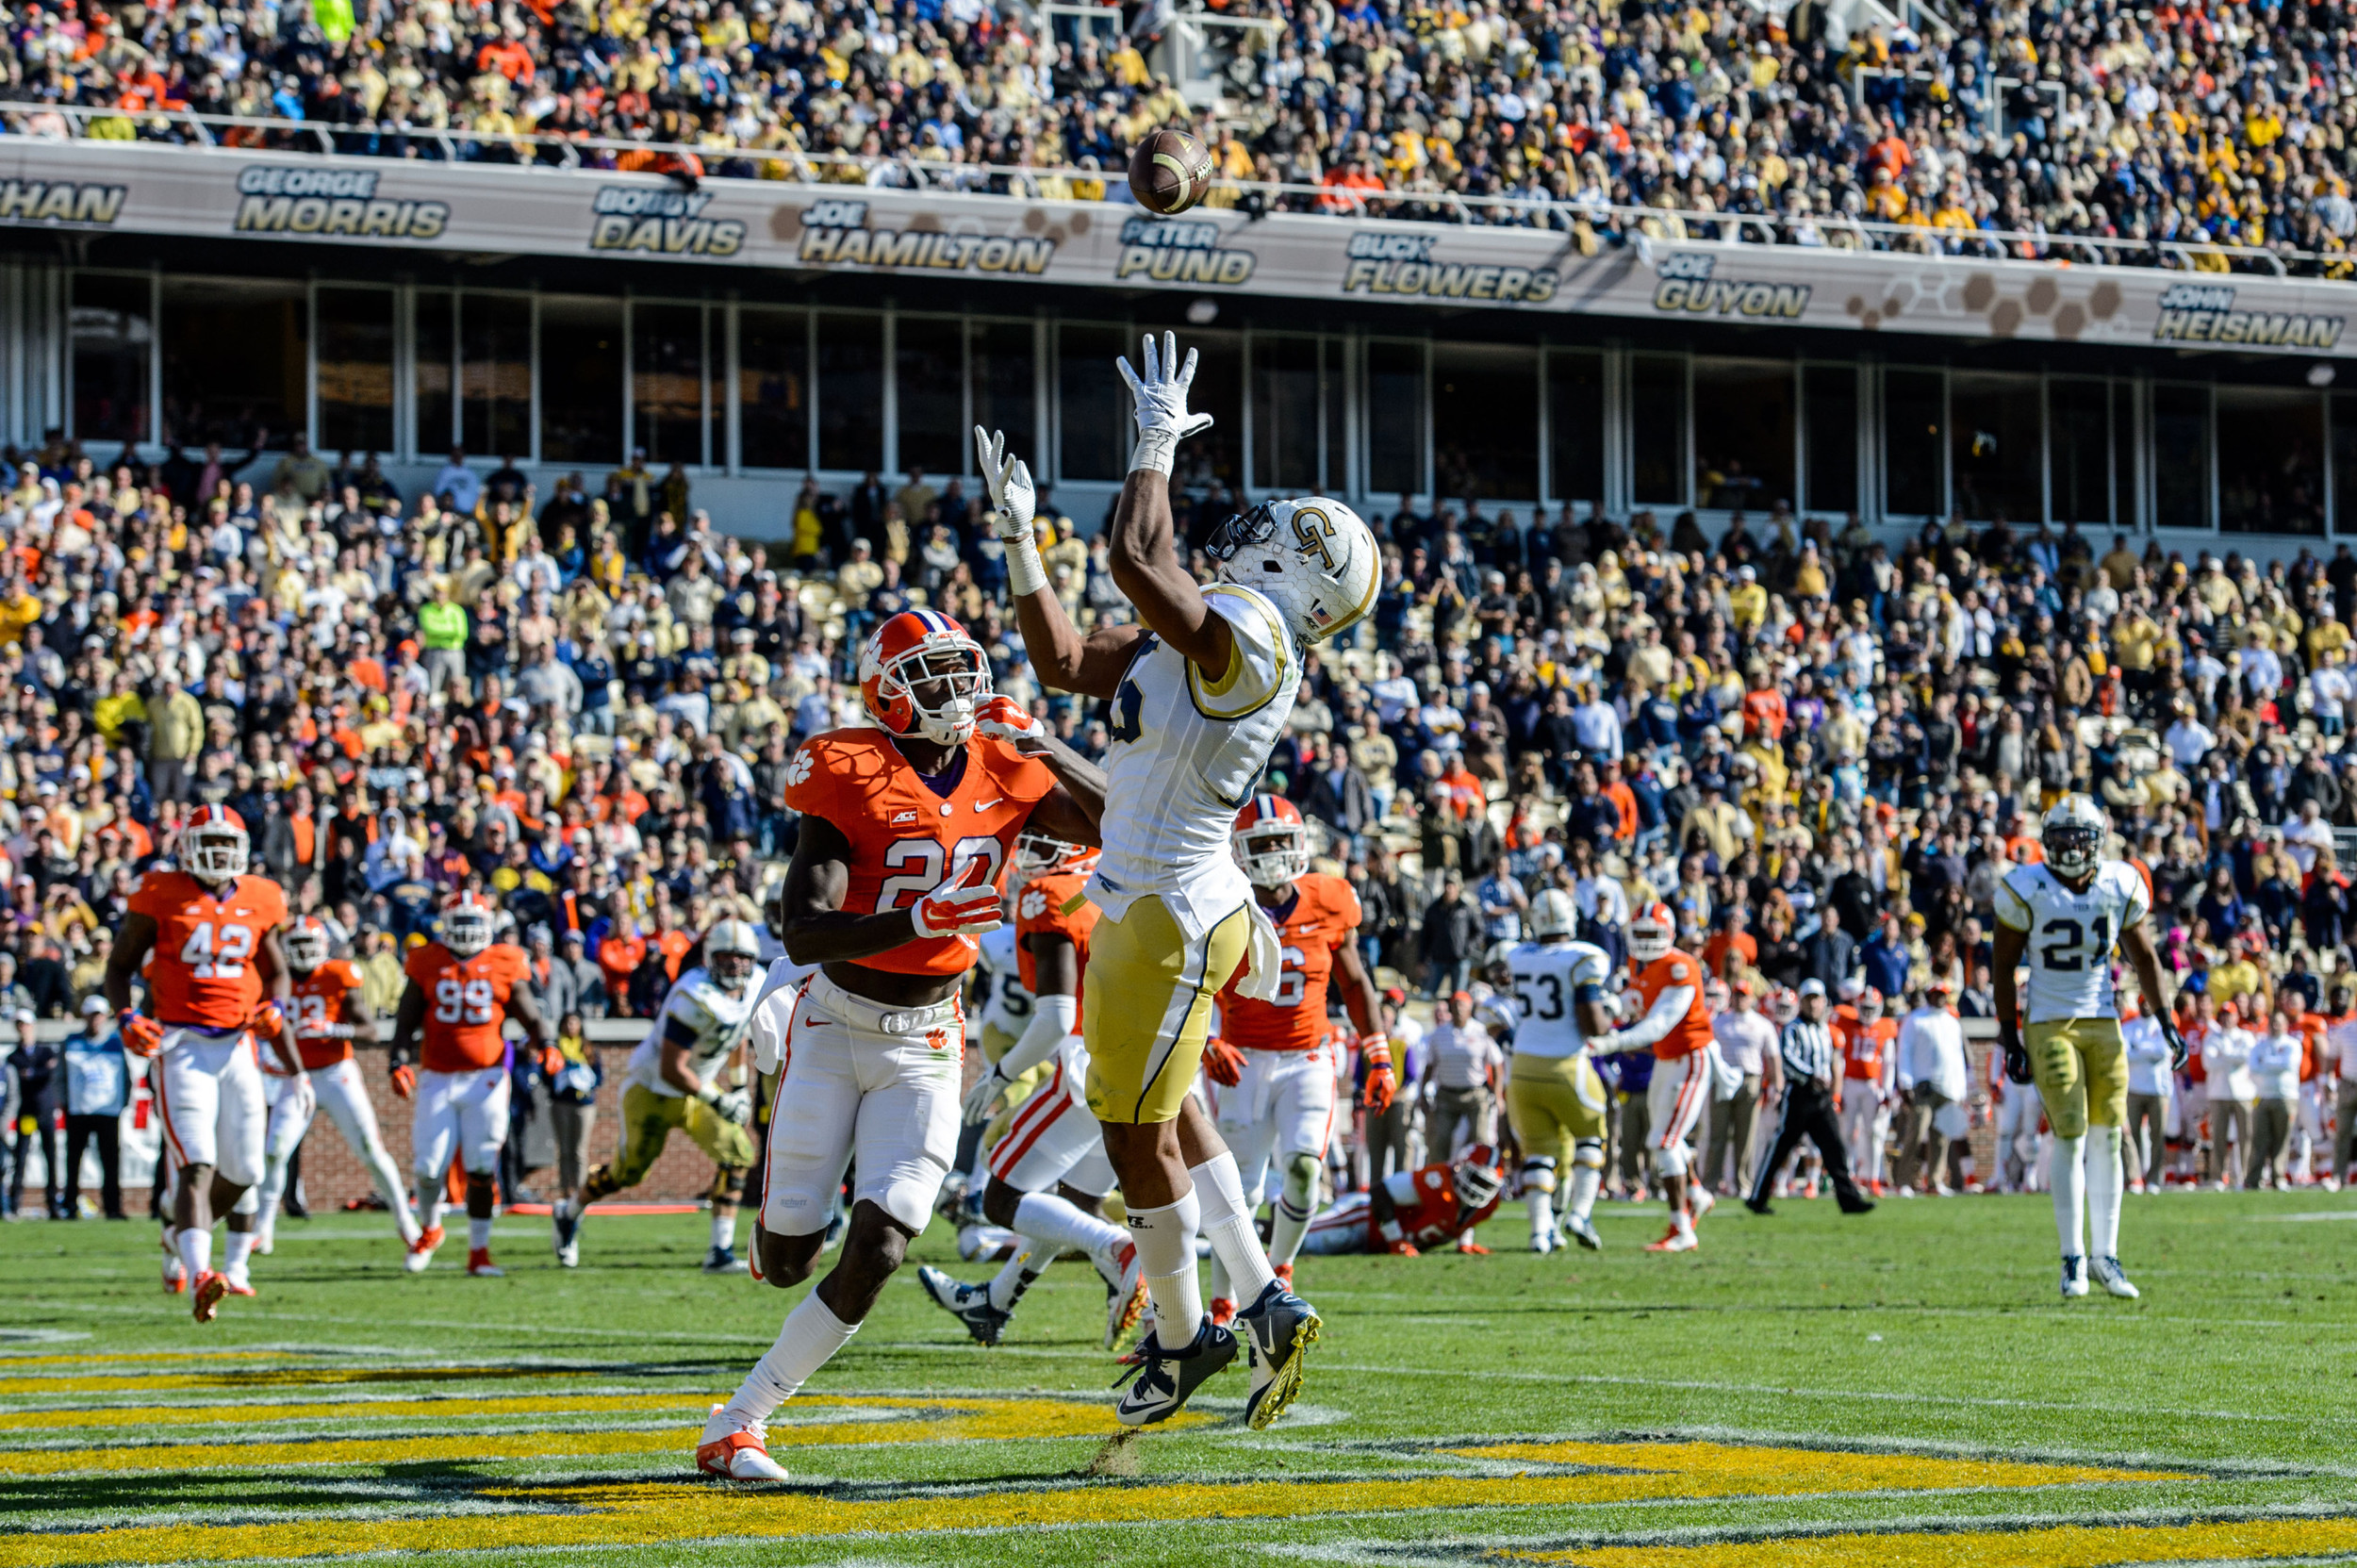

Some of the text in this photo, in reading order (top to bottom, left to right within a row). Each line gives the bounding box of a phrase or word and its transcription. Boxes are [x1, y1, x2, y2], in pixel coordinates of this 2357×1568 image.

[0, 178, 125, 223] HAN
[239, 167, 378, 197] GEORGE
[236, 195, 449, 238] MORRIS
[595, 188, 712, 218] BOBBY
[801, 200, 867, 228] JOE
[591, 216, 745, 256] DAVIS
[799, 227, 1054, 273] HAMILTON
[1121, 218, 1219, 248] PETER
[1347, 233, 1436, 261] BUCK
[1117, 245, 1256, 284] PUND
[1344, 259, 1558, 303] FLOWERS
[1658, 253, 1715, 279] JOE
[1656, 278, 1811, 318] GUYON
[2158, 285, 2235, 311] JOHN
[2154, 308, 2346, 348] HEISMAN
[892, 810, 918, 823] ACC
[873, 834, 1004, 916] 20
[180, 920, 253, 979] 42
[2040, 915, 2110, 972] 21
[435, 978, 494, 1025] 99
[1513, 973, 1565, 1021] 53
